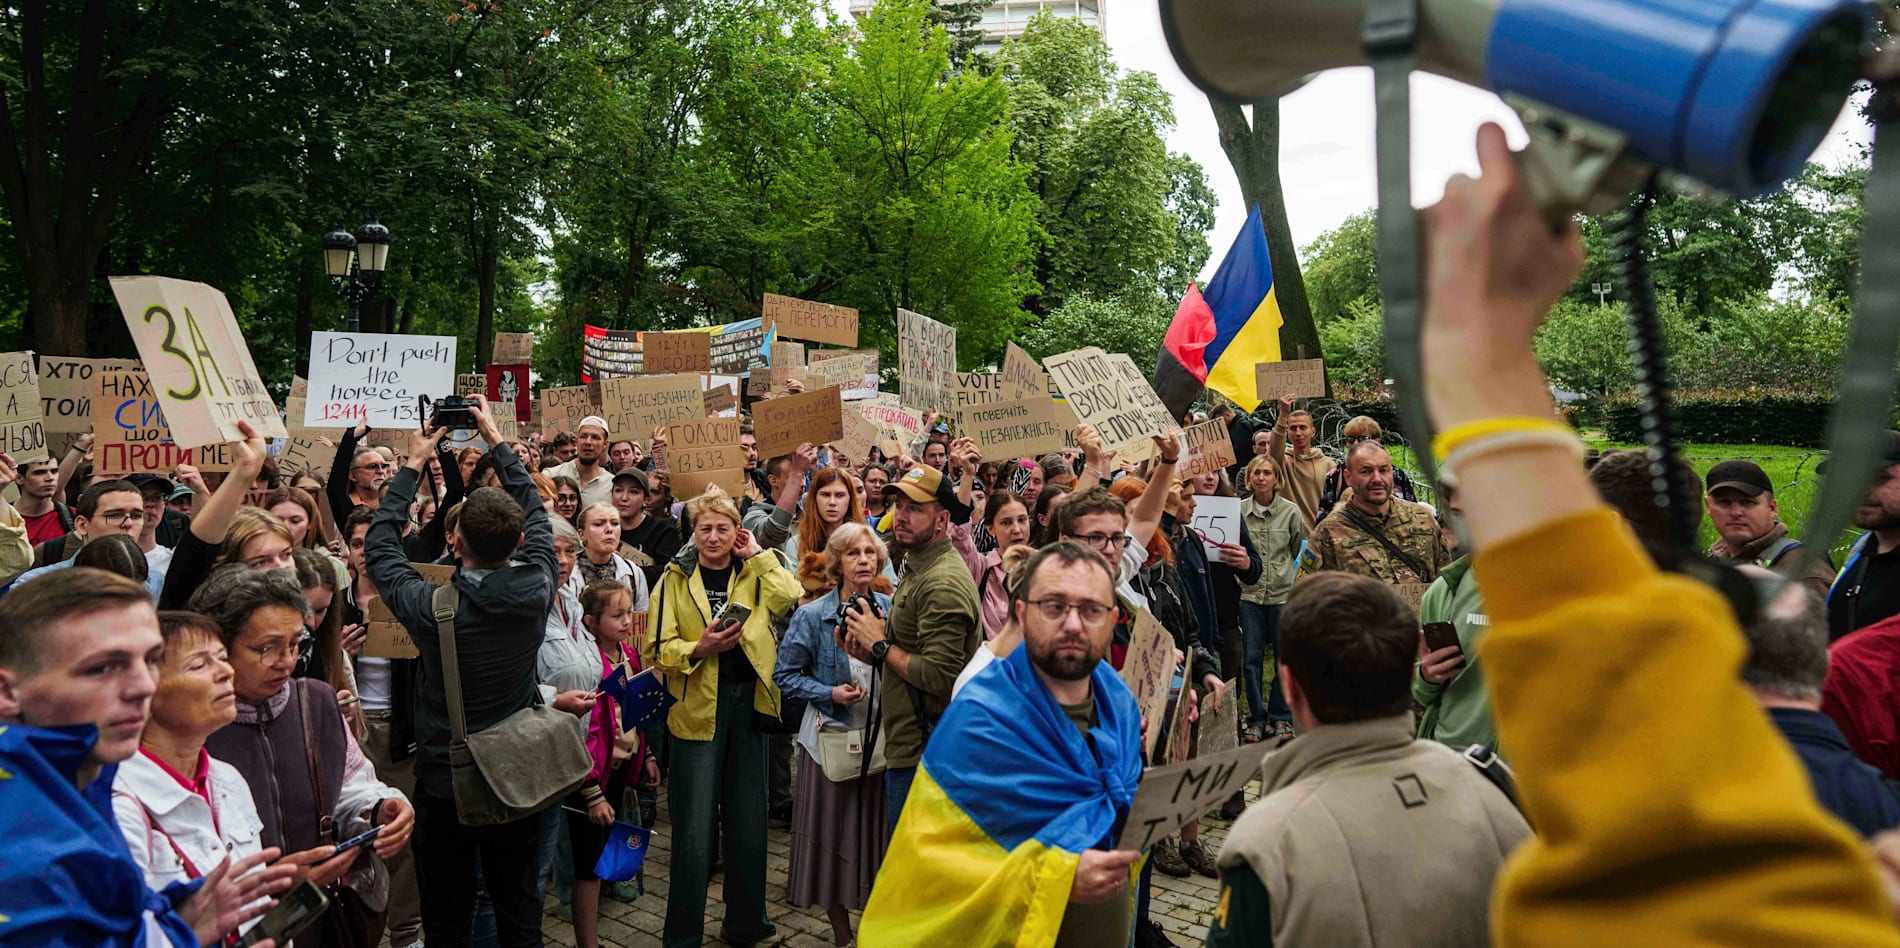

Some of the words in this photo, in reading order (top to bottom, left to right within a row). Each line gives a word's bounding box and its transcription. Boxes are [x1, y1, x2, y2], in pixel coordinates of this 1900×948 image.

[765, 307, 783, 324] НЕ
[789, 309, 857, 332] ПЕРЕМОГТИ
[901, 312, 916, 338] ЯК
[921, 321, 954, 349] ВОНО
[143, 304, 231, 401] ЗА
[321, 337, 390, 364] Don't
[400, 341, 449, 368] push
[658, 340, 696, 350] 12414
[46, 362, 93, 379] ХТО
[361, 366, 402, 384] the
[1275, 373, 1294, 386] TO
[459, 376, 483, 388] ЩОБ
[605, 380, 621, 399] НІ
[957, 373, 1001, 389] VOTE
[330, 384, 414, 402] horses
[620, 389, 699, 411] СКАСУВАННЮ
[957, 391, 1003, 406] FUTU
[1268, 385, 1289, 399] ARE
[41, 396, 91, 417] ТОЙ
[861, 405, 874, 420] НЕ
[973, 405, 1029, 422] ПОВЕРНІТЬ
[607, 411, 638, 434] САП
[641, 414, 657, 425] ТА
[658, 405, 699, 427] НАБУ
[980, 420, 1056, 446] НЕЗАЛЕЖНІСТЬ
[102, 443, 193, 473] ПРОТИ
[1171, 760, 1238, 804] МИ
